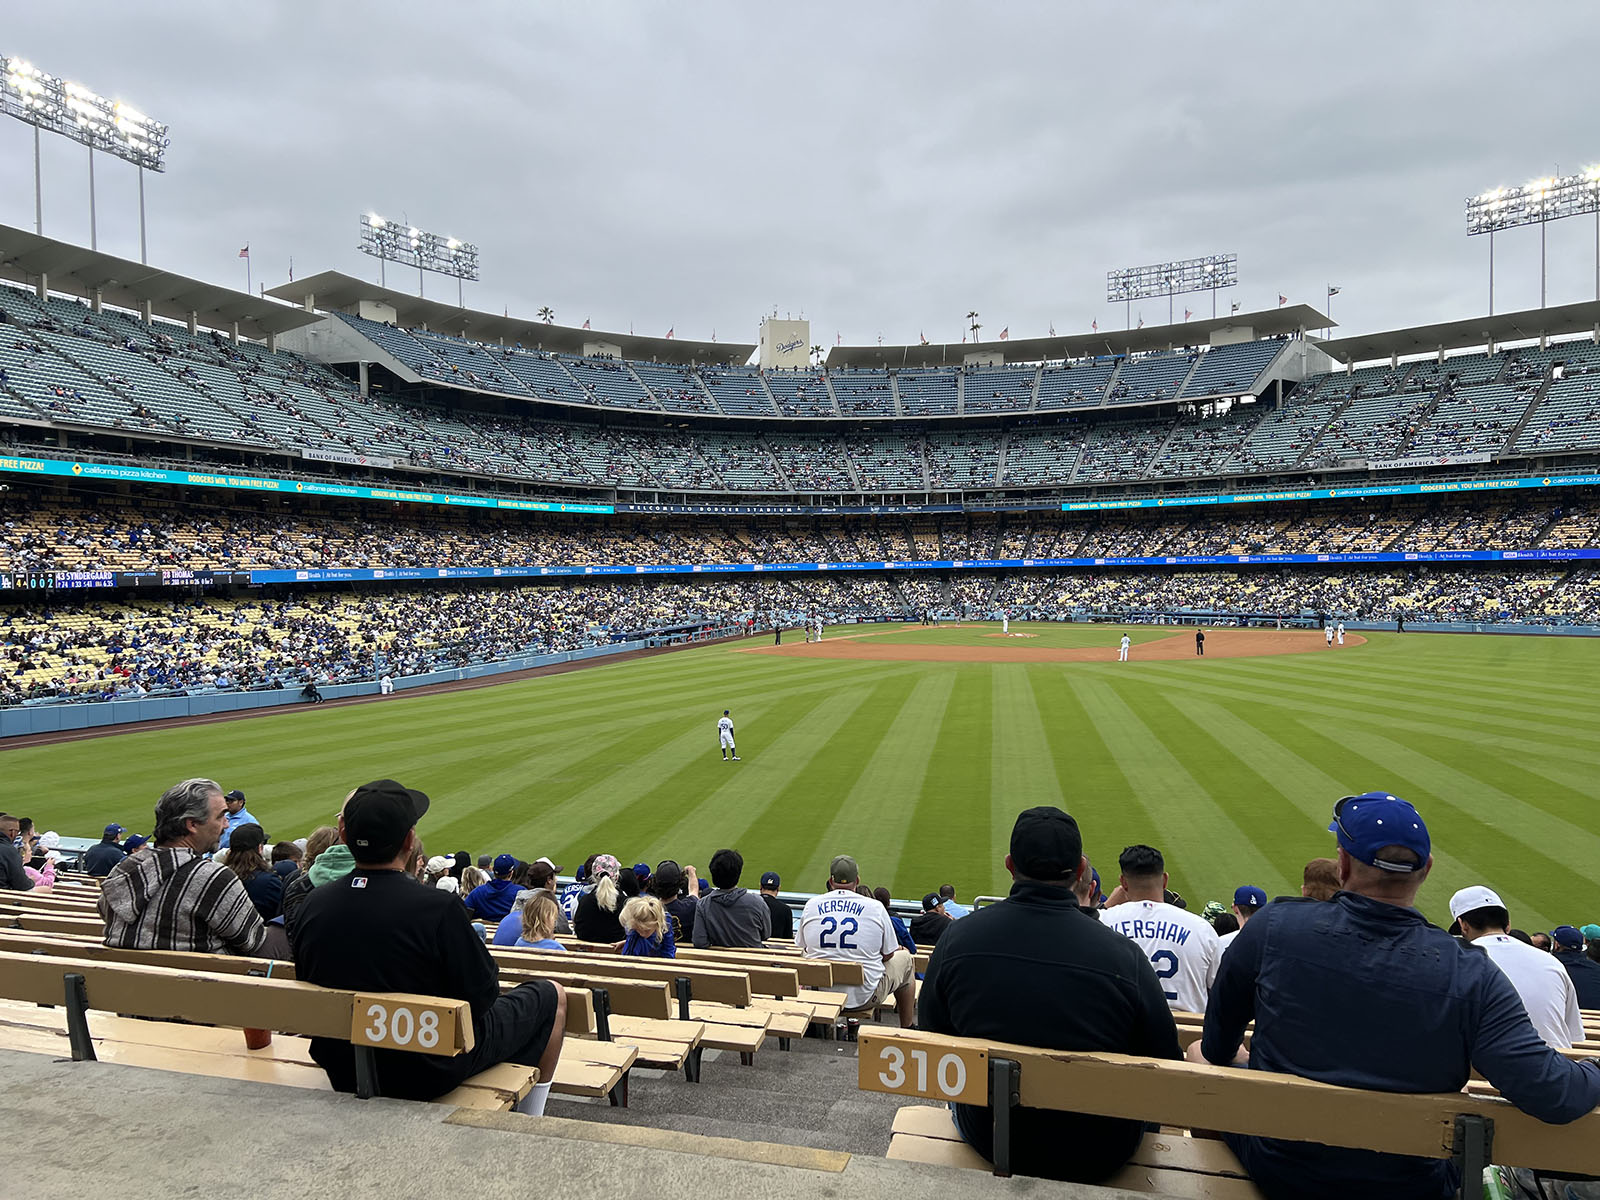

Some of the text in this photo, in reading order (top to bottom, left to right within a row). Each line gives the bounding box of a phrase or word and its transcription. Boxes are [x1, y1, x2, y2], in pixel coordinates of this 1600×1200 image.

[776, 338, 805, 354] Dodgers
[0, 459, 44, 470] FREE PIZZA!
[84, 467, 167, 479] california pizza kitchen
[188, 474, 214, 483] DODGERS
[250, 479, 263, 487] FREE
[1, 574, 11, 588] LA
[66, 572, 112, 580] SYNDERGAARD
[31, 578, 53, 588] 0 0 2
[565, 884, 584, 894] KERSH
[818, 900, 865, 916] KERSHAW
[820, 916, 858, 949] 22
[365, 1004, 439, 1048] 308
[878, 1046, 966, 1096] 310
